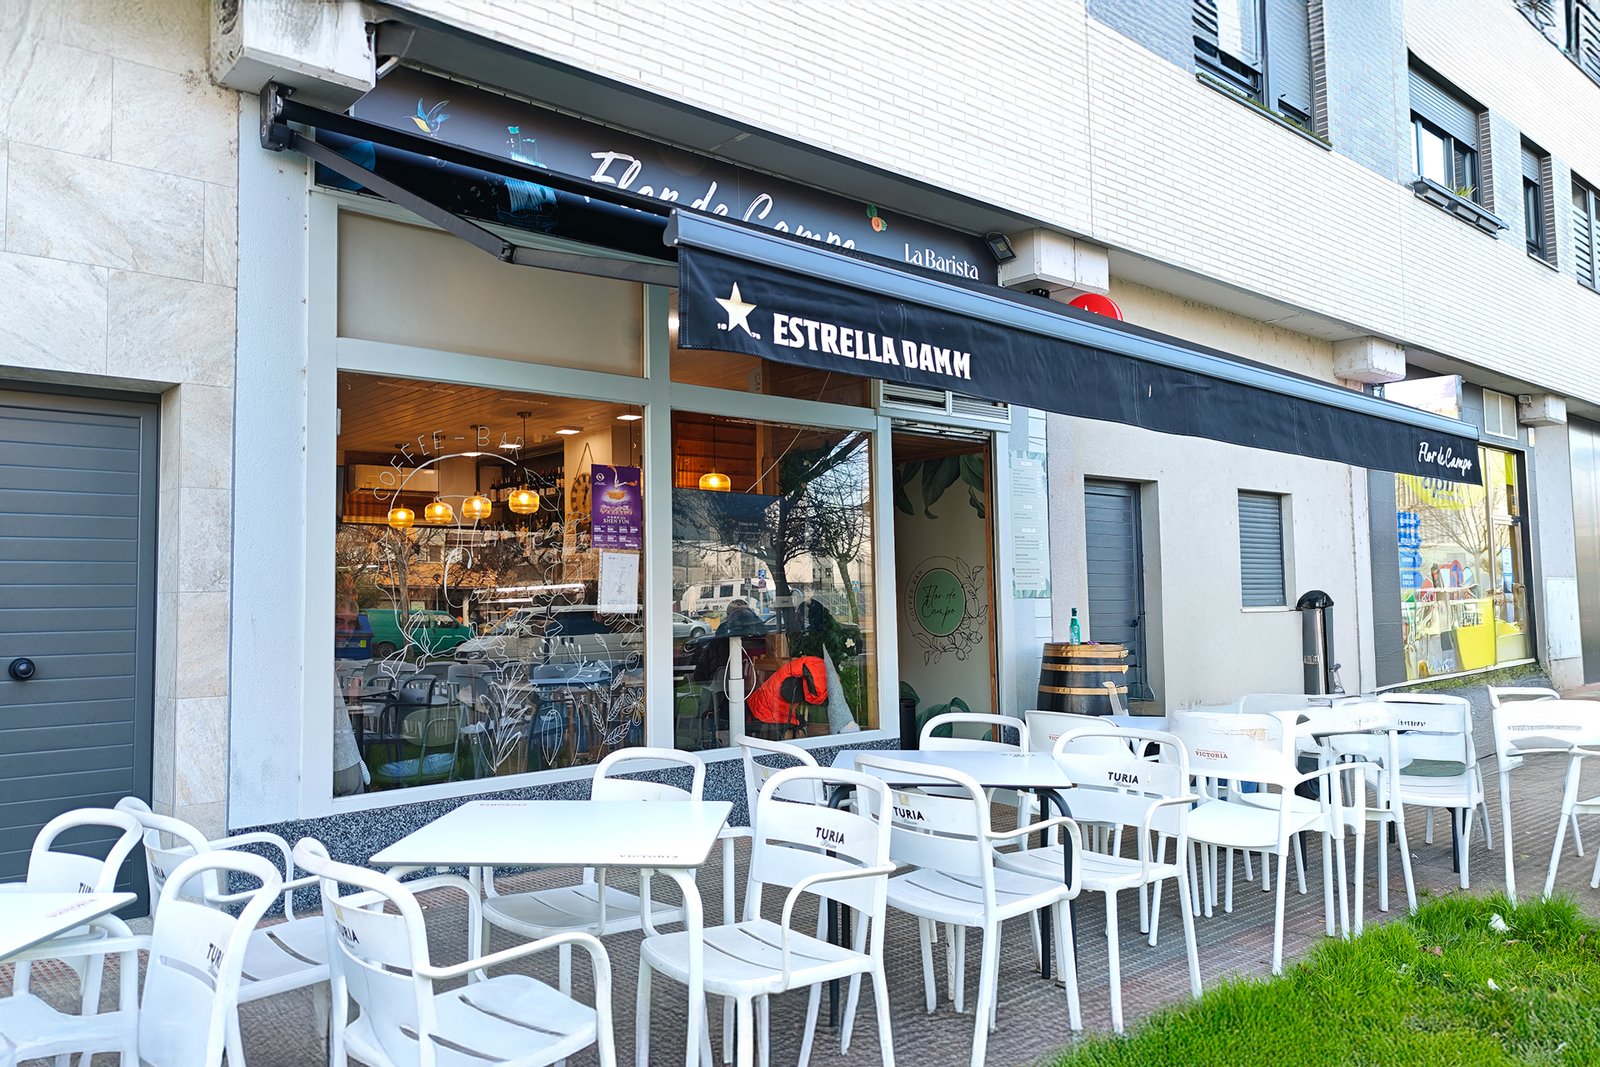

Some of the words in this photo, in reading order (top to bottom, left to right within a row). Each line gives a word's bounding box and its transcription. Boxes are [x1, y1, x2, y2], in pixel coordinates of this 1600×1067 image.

[773, 313, 900, 366] ESTRELLA
[901, 340, 972, 380] DAMM
[1195, 750, 1228, 759] VICTORIA
[1108, 771, 1139, 784] TURIA
[893, 806, 925, 821] TURIA
[816, 826, 845, 845] TURIA
